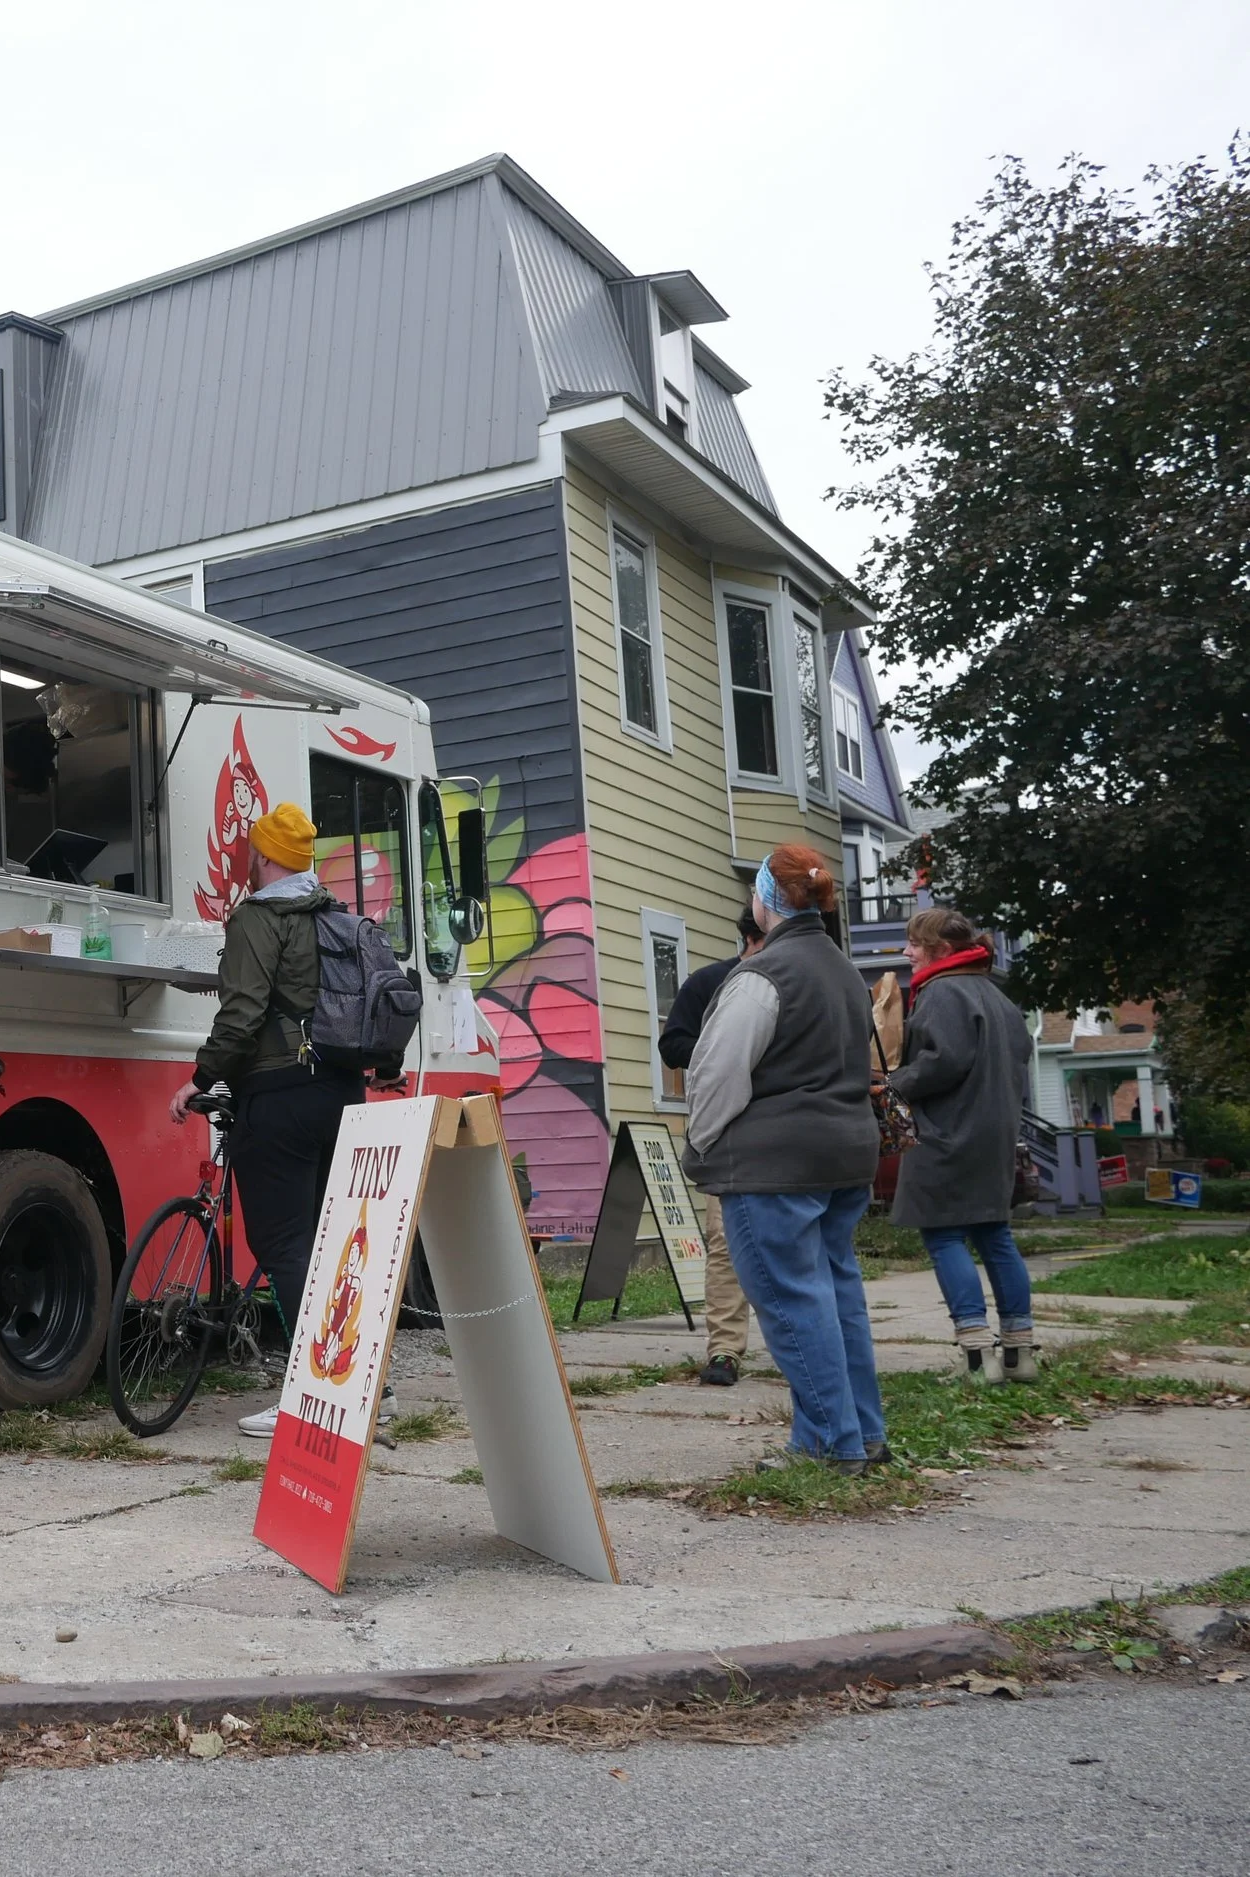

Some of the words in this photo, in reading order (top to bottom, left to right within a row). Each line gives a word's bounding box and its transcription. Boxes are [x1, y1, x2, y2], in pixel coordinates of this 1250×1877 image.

[643, 1140, 664, 1160] FOOD
[347, 1145, 403, 1201] TINY
[648, 1162, 674, 1182] TRUCK
[658, 1184, 677, 1203] NOW
[664, 1206, 684, 1225] OPEN
[379, 1199, 408, 1324] MIGHTY
[359, 1342, 379, 1415] KICK
[295, 1392, 347, 1464] THAI
